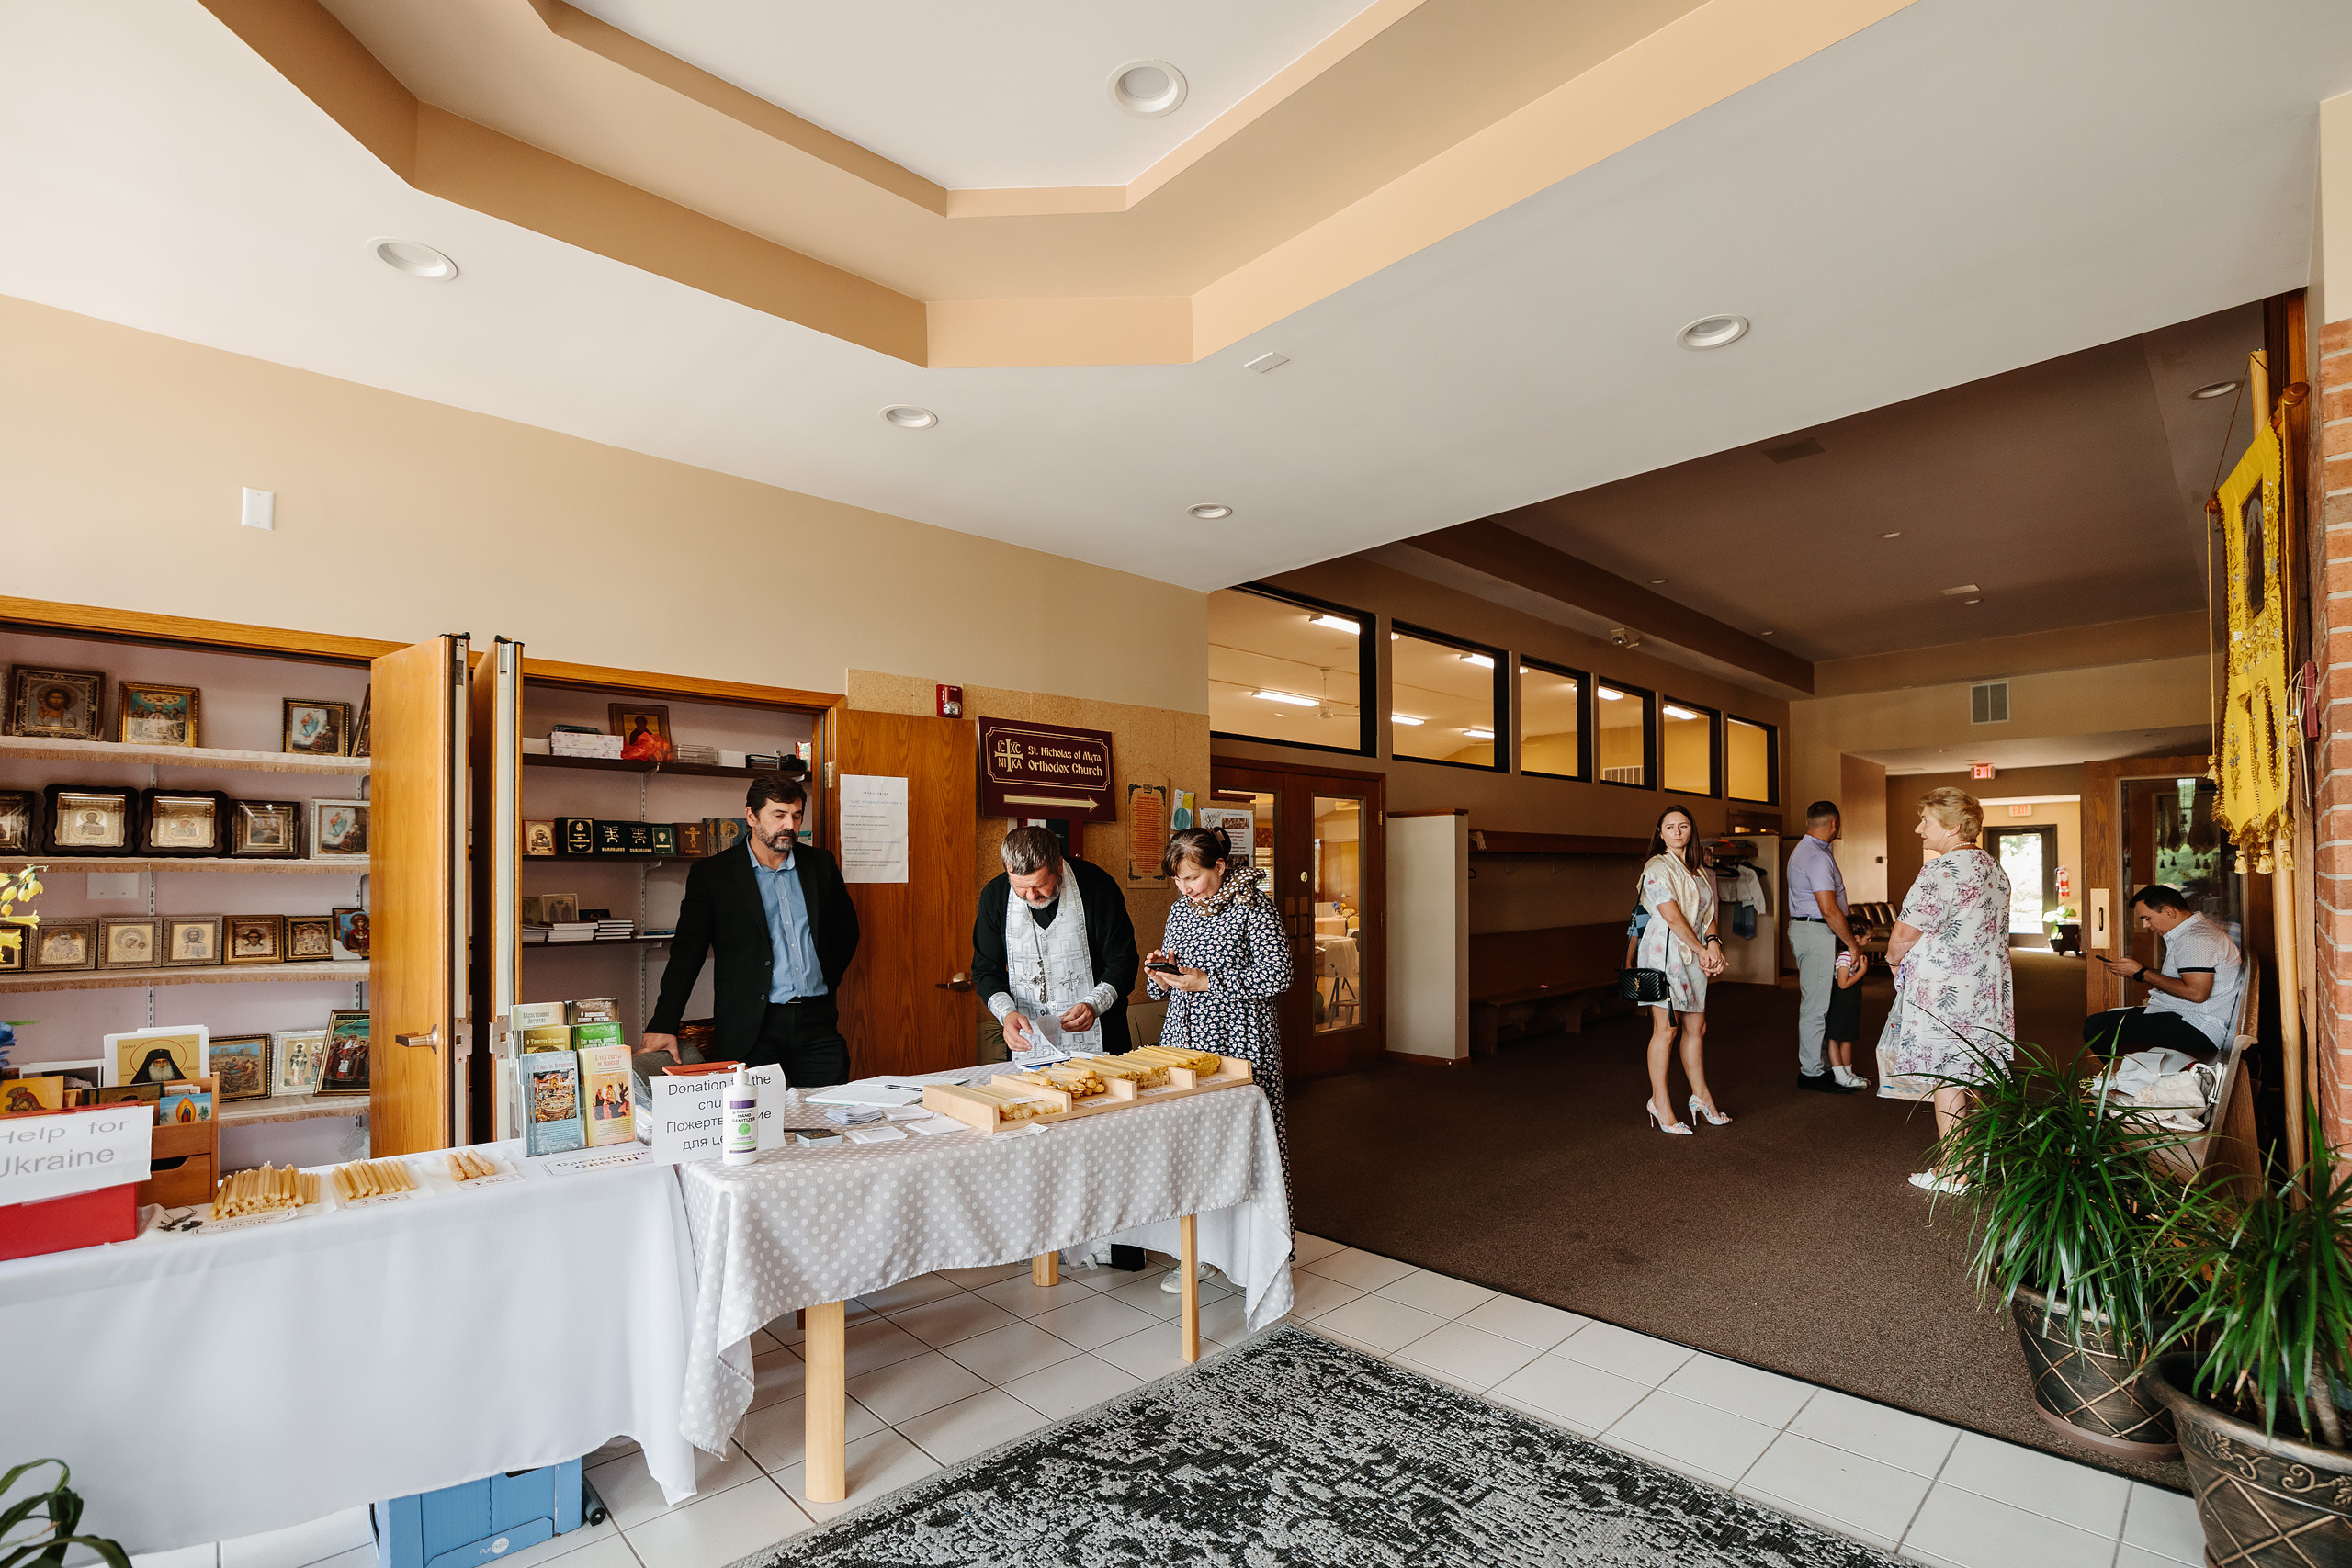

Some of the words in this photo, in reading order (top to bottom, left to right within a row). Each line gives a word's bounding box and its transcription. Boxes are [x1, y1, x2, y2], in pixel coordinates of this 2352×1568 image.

[1041, 747, 1072, 759] Nicholas
[1074, 750, 1081, 760] of
[1083, 751, 1102, 763] Myra
[1028, 760, 1069, 773] Orthodox
[1072, 763, 1102, 776] Church
[1973, 766, 1992, 779] EXIT
[2012, 805, 2029, 815] EXIT
[668, 1079, 727, 1096] Donation
[752, 1075, 772, 1086] the
[698, 1099, 722, 1110] chu
[89, 1121, 130, 1134] for
[682, 1138, 708, 1152] для
